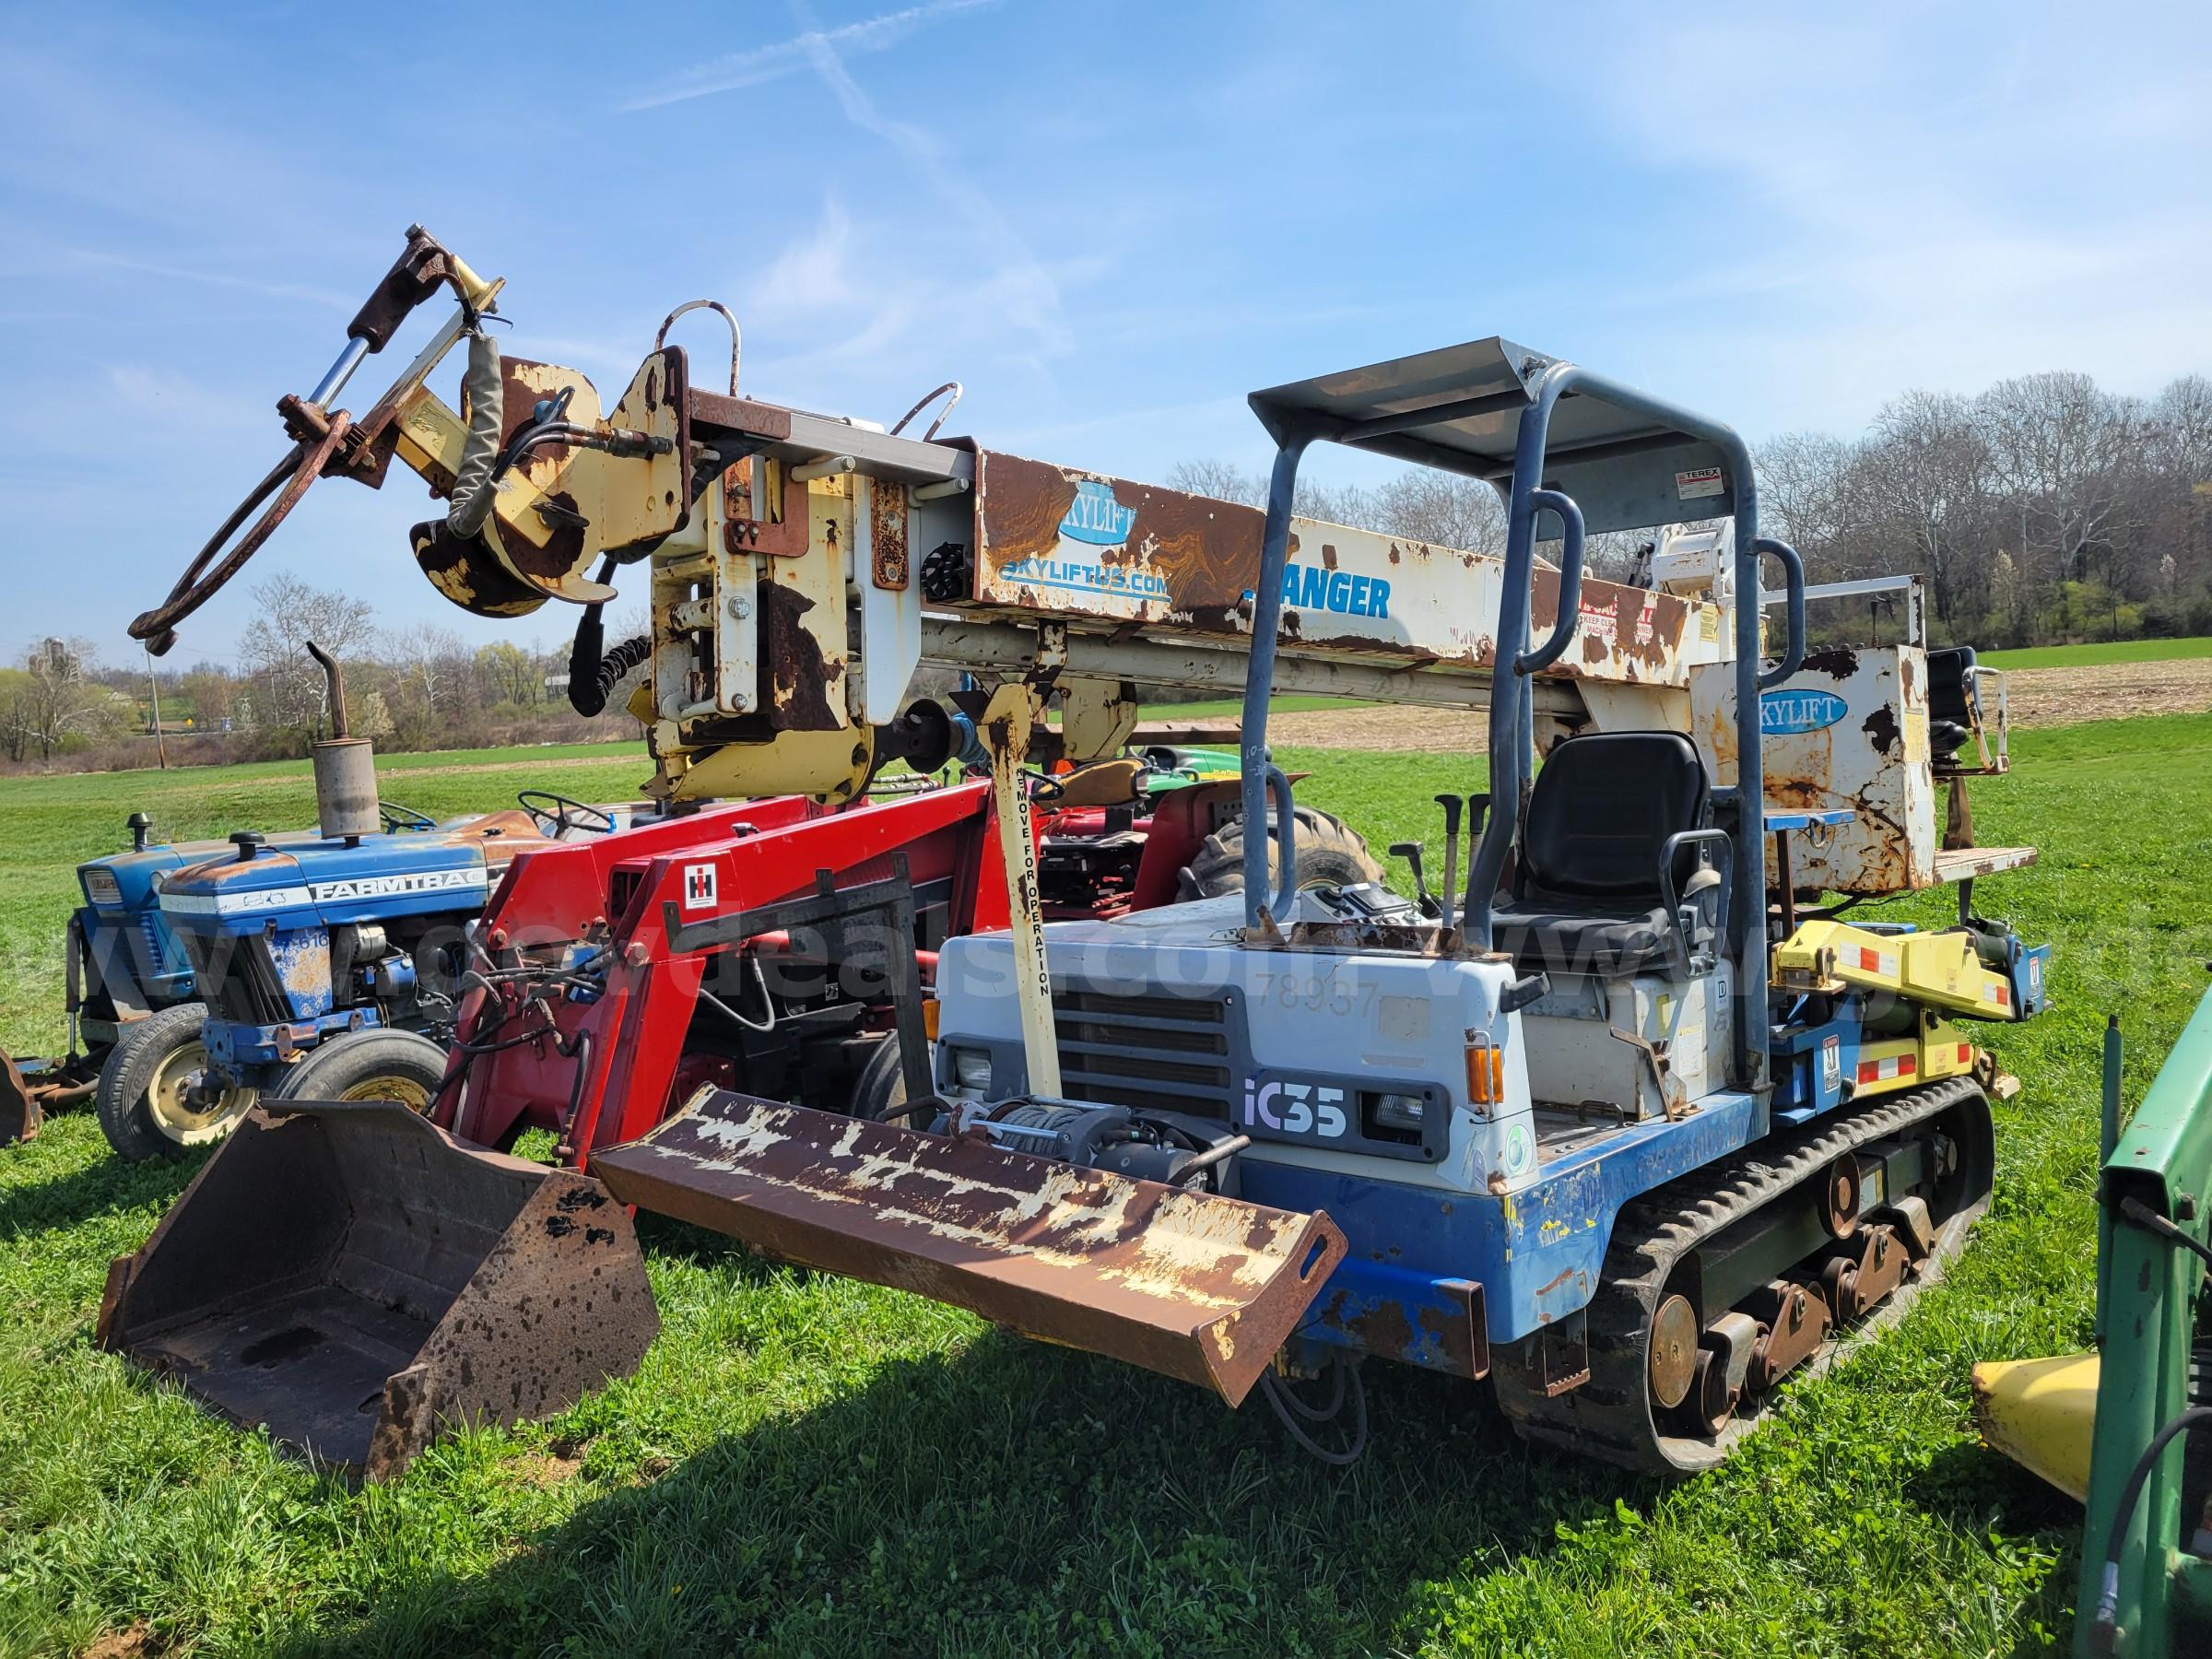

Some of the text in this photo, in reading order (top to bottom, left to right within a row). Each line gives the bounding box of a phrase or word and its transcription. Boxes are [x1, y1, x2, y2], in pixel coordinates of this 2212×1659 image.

[1687, 468, 1719, 478] TEREX
[1064, 493, 1137, 534] KYLIFT
[1243, 562, 1391, 619] ANGER
[1583, 615, 1599, 625] KEEP
[1761, 697, 1837, 726] KYLIFT
[1016, 767, 1049, 996] REMOVE FOR OPERATION
[1255, 972, 1379, 1018] 78937
